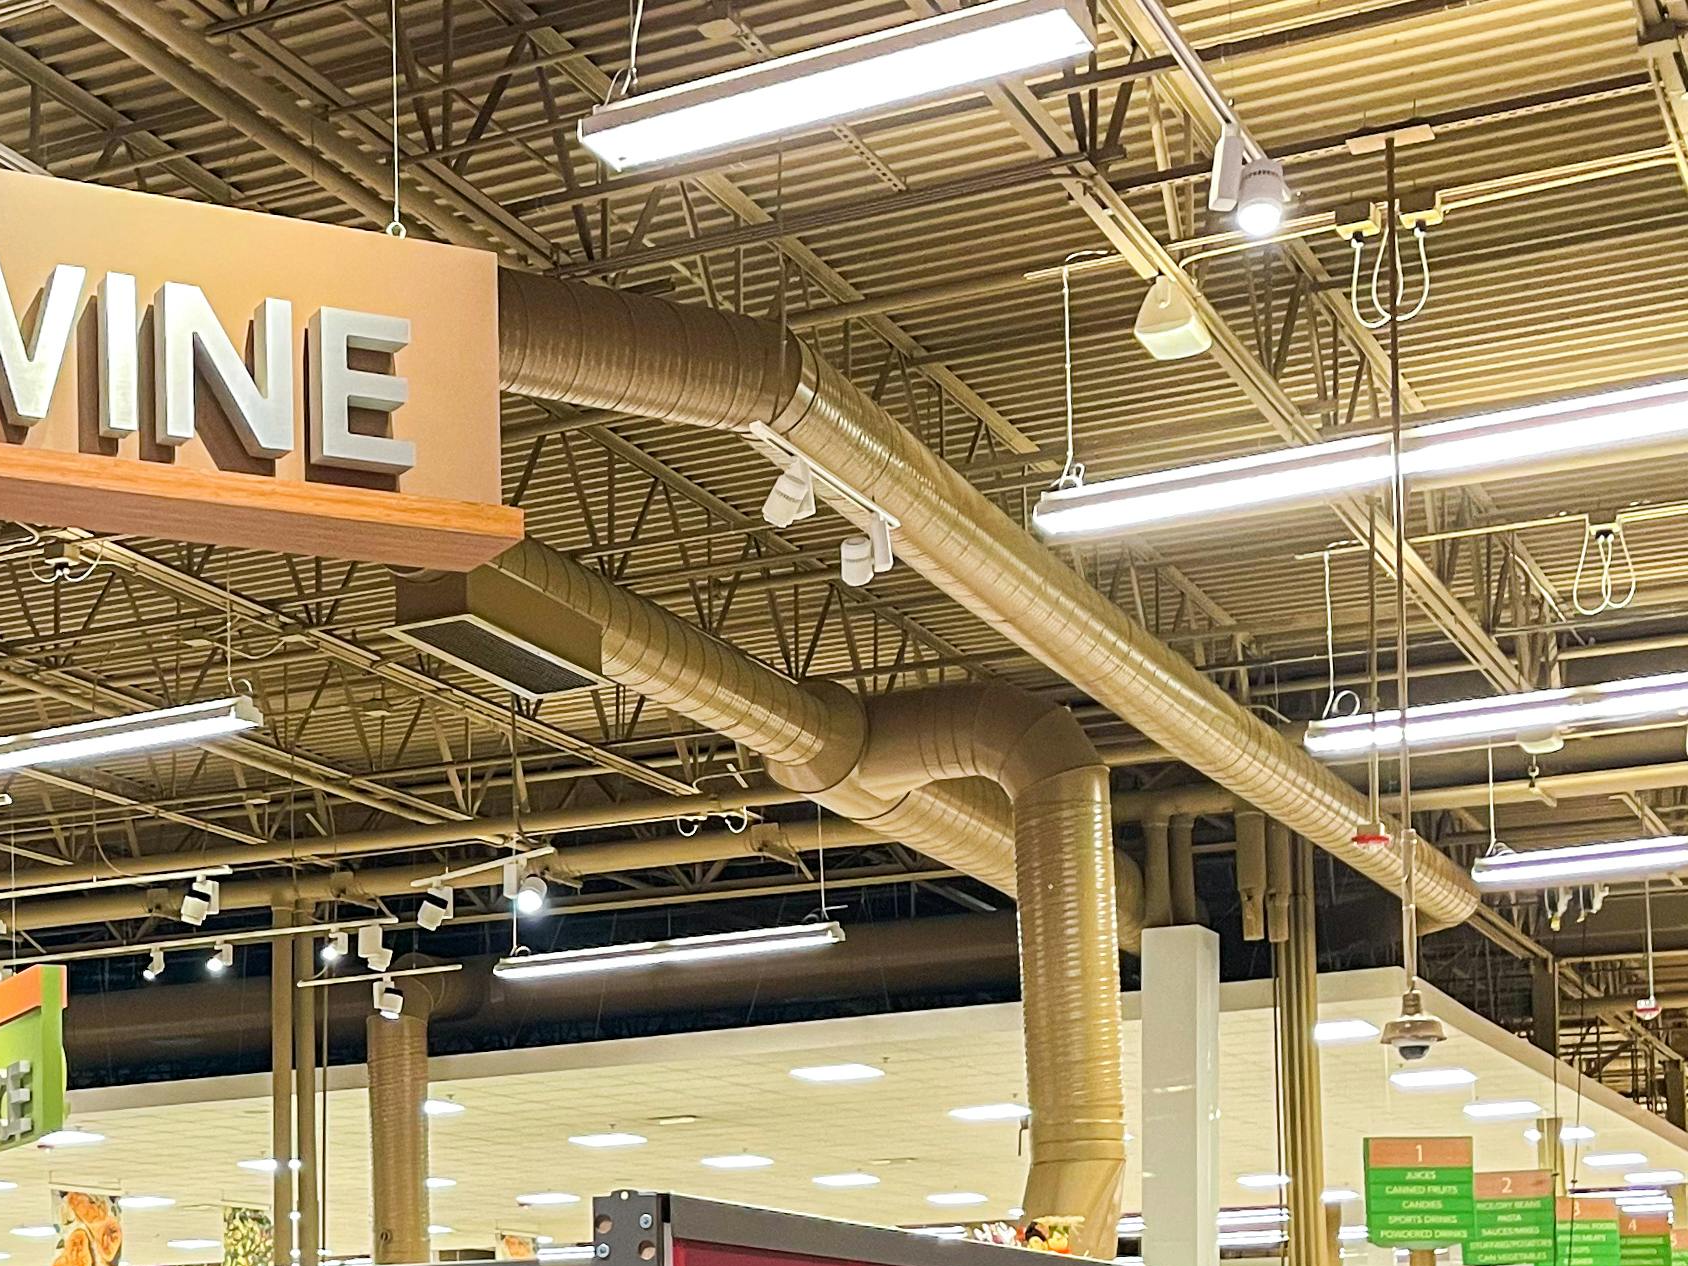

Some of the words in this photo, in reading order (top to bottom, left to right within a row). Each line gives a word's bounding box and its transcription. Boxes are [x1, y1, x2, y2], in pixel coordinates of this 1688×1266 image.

[1415, 1144, 1424, 1163] 1
[1405, 1170, 1437, 1180] JUICES
[1385, 1186, 1426, 1195] CANNED
[1427, 1185, 1458, 1194] FRUITS
[1501, 1177, 1512, 1194] 2
[1402, 1200, 1443, 1209] CANDIES
[1514, 1200, 1541, 1209] BEANS
[1388, 1215, 1423, 1224] SPORTS
[1424, 1215, 1457, 1224] DRINKS
[1497, 1214, 1522, 1222] PASTA
[1627, 1218, 1637, 1231] 4
[1380, 1230, 1432, 1239] POWDERED
[1434, 1229, 1468, 1238] DRINKS
[1497, 1252, 1548, 1261] VEGETABLES
